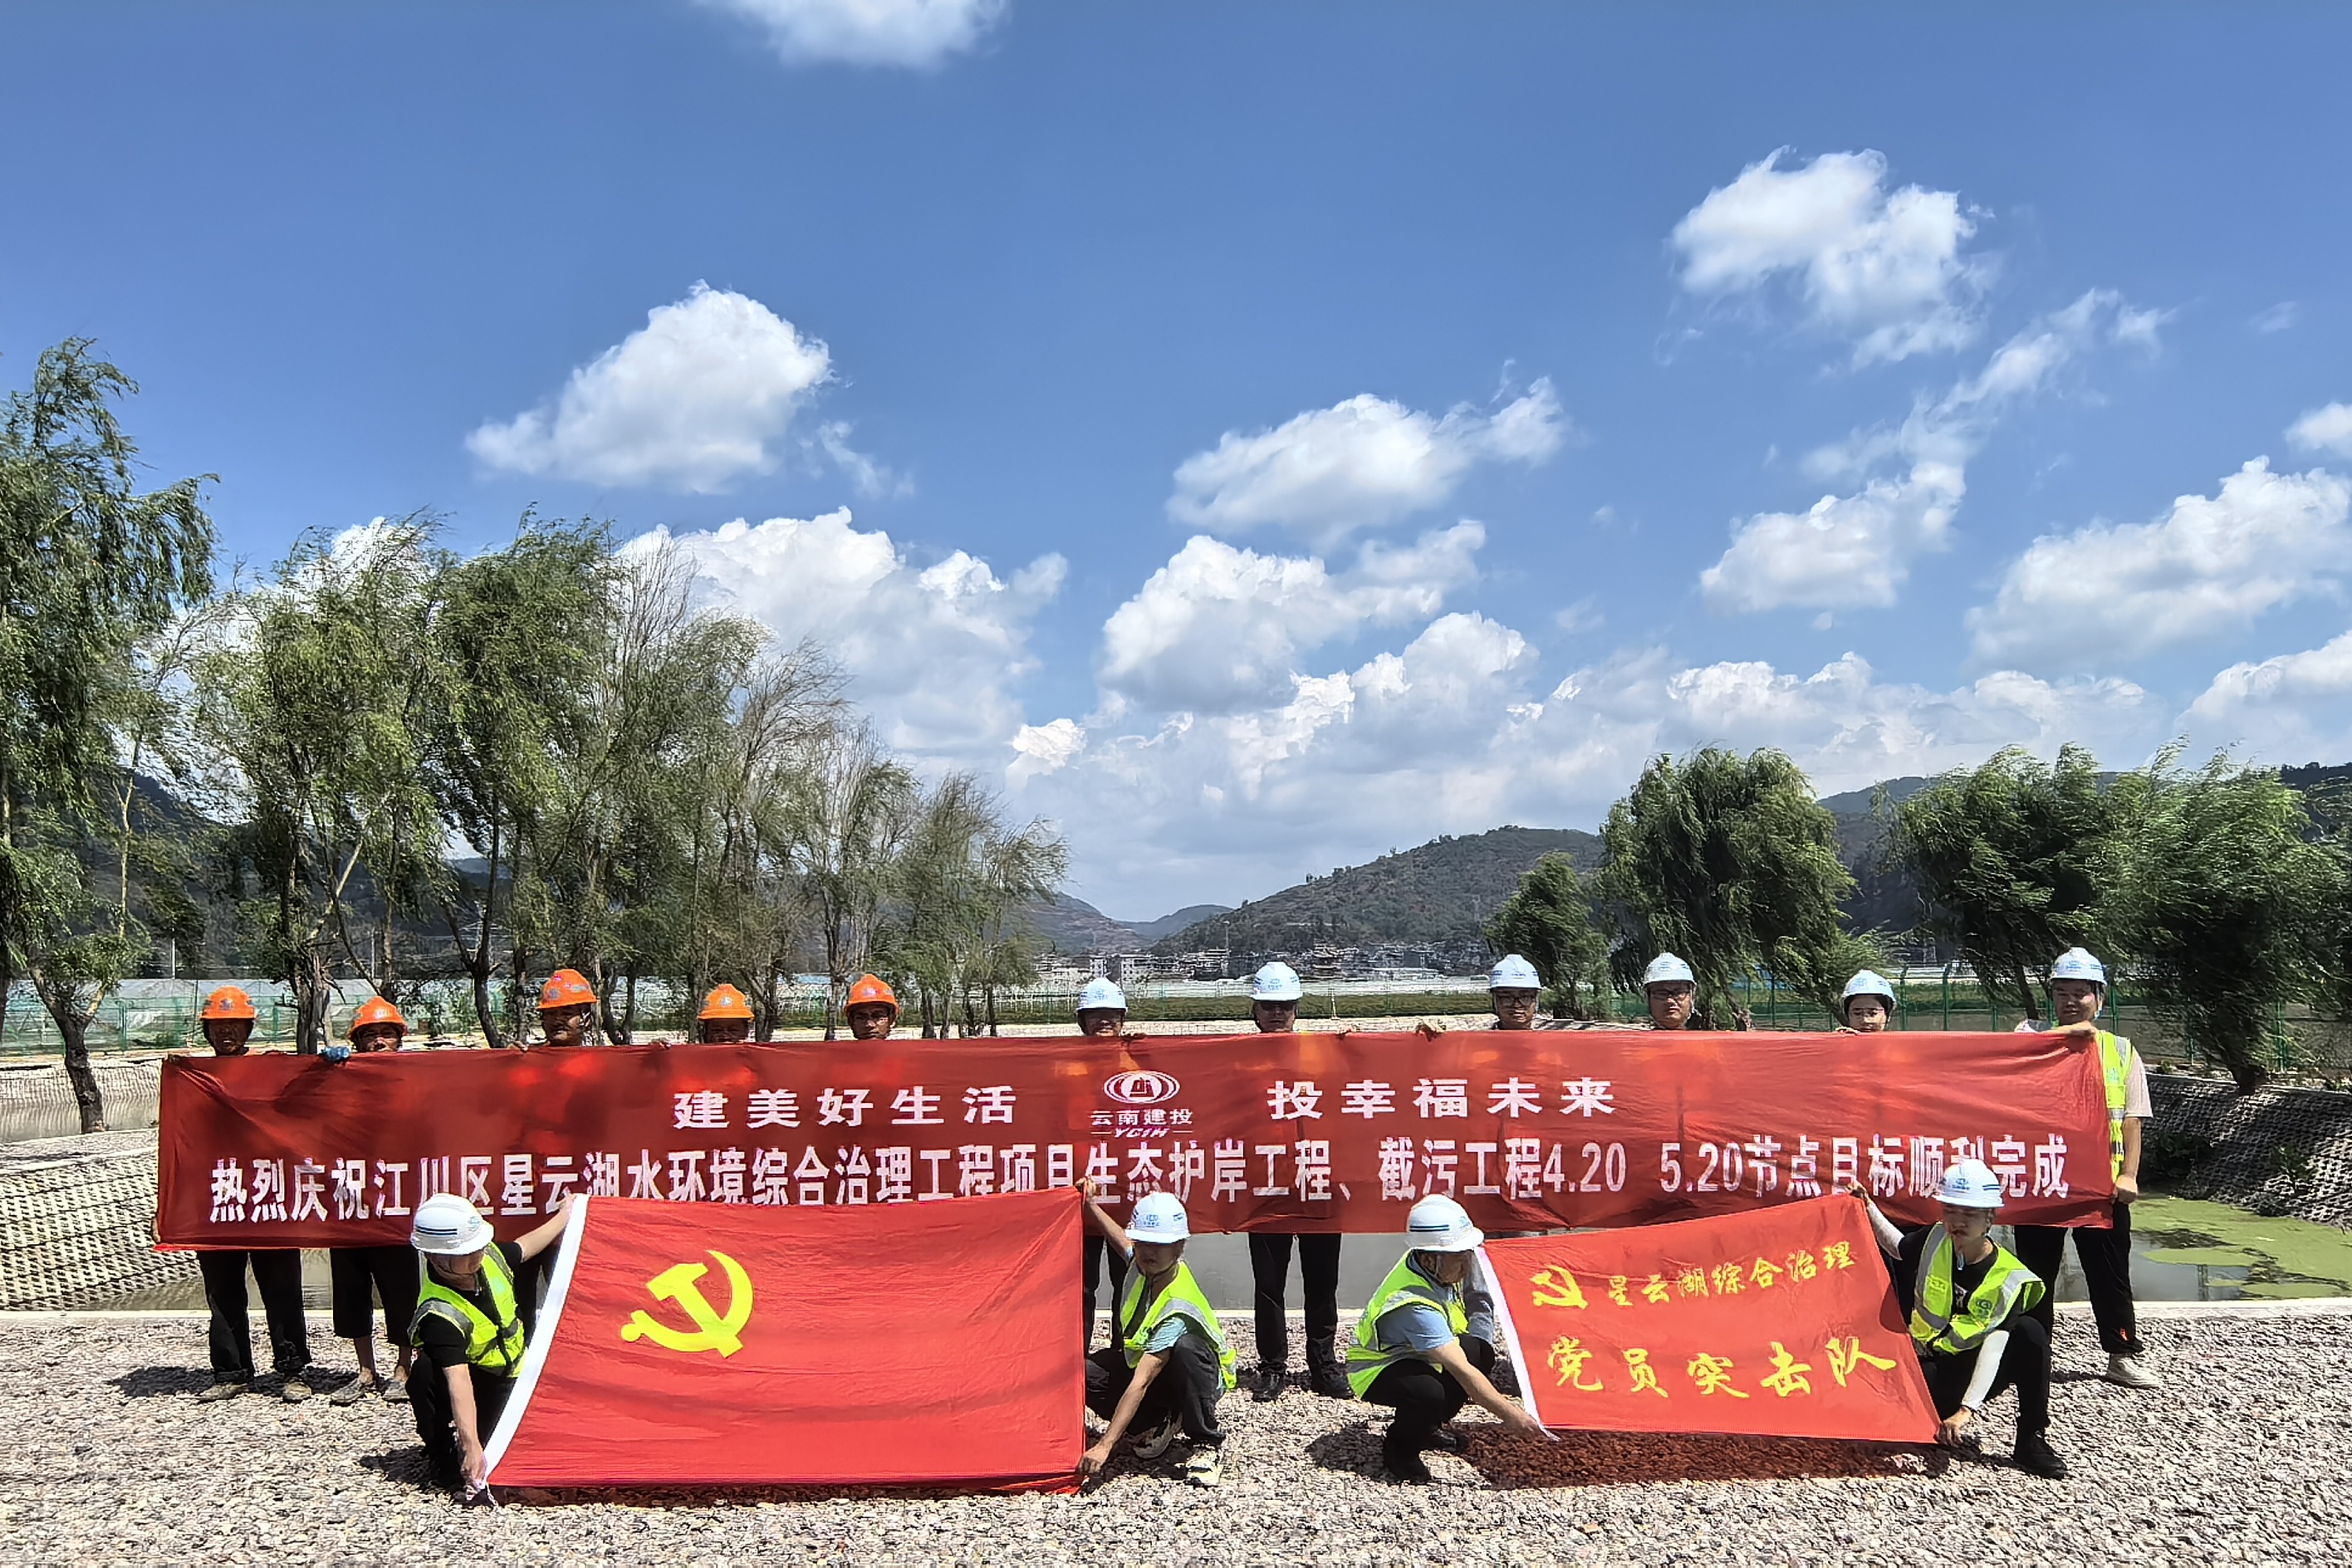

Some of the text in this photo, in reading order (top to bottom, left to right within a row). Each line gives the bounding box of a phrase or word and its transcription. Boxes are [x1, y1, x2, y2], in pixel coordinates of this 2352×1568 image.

[674, 1086, 1017, 1129] 建美好生活
[1090, 1108, 1193, 1126] 云南建投
[1267, 1077, 1615, 1120] 投幸福未来
[1608, 1240, 1856, 1306] 星云湖综合治理
[1546, 1335, 1897, 1399] 党员突击队
